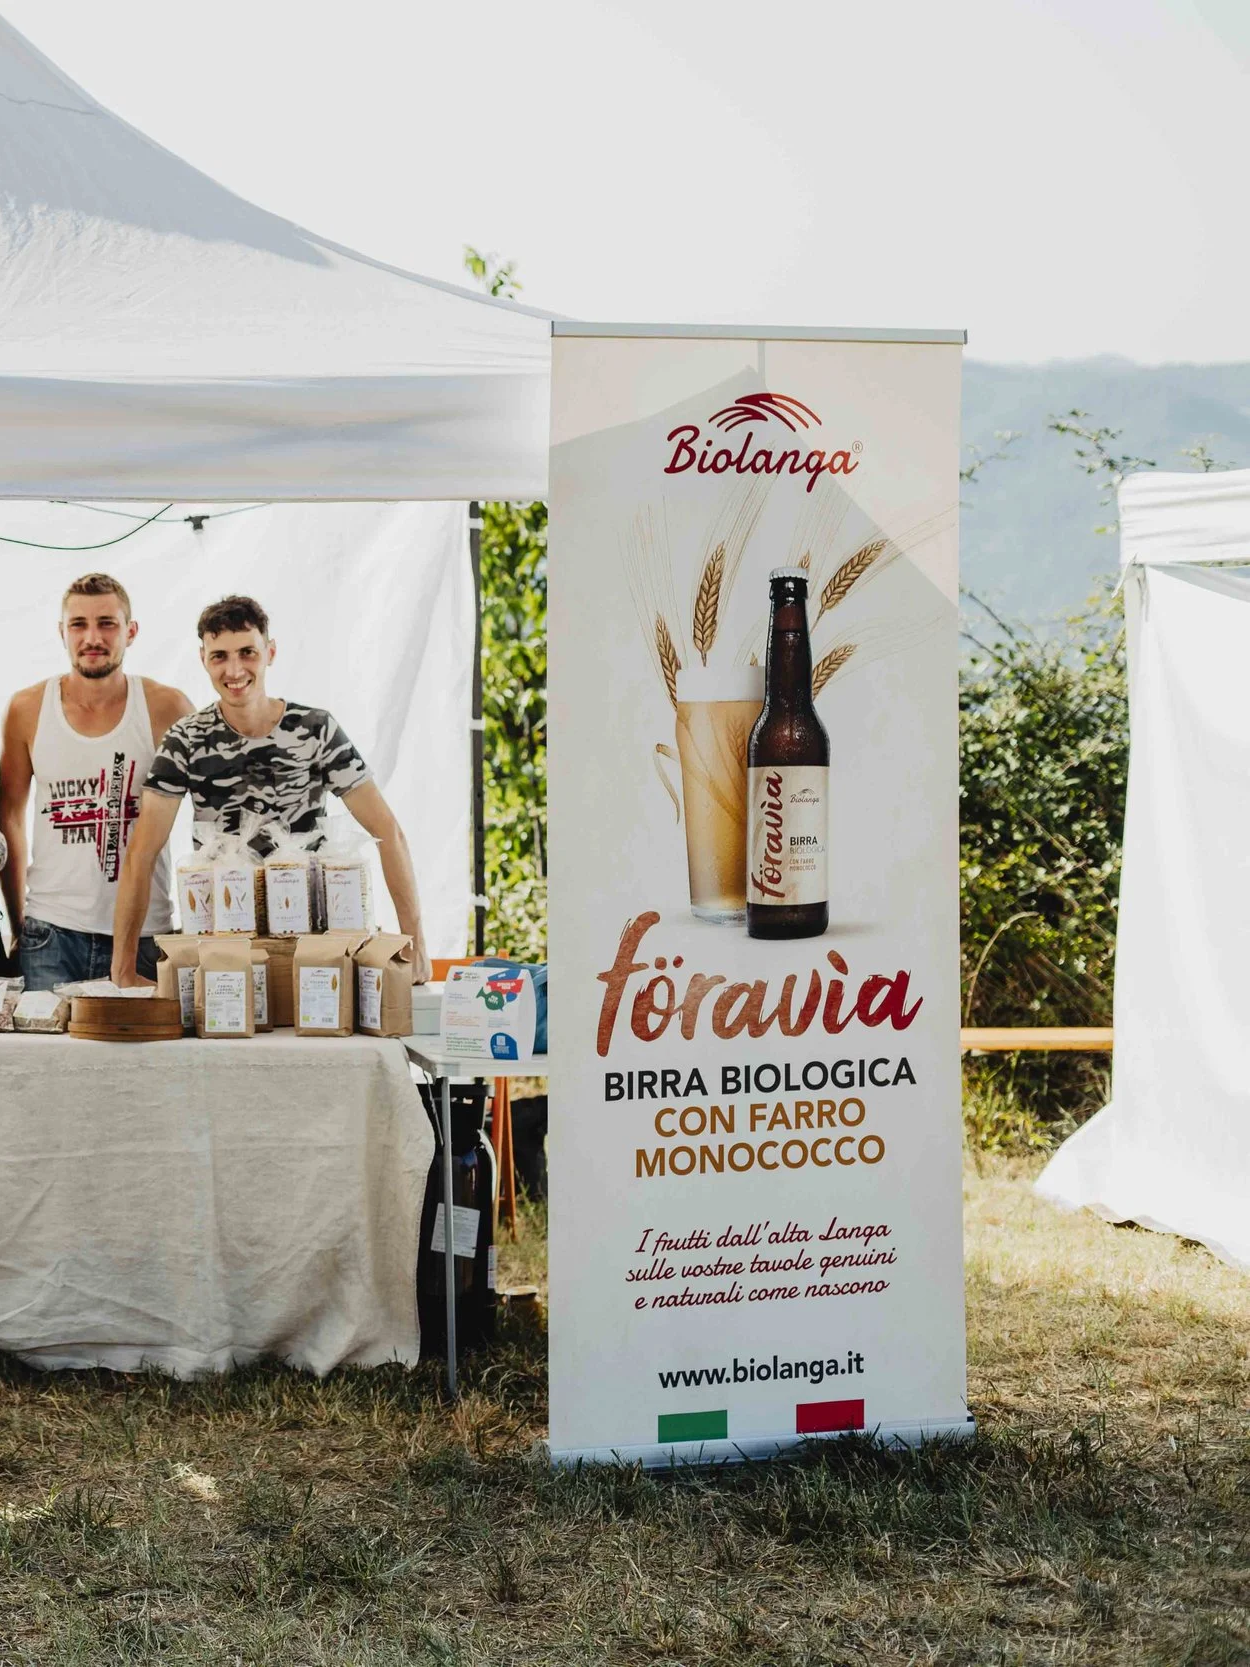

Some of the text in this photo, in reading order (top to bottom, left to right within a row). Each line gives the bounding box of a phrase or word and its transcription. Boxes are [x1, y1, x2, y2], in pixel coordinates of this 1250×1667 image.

[49, 779, 98, 799] LUCKY
[790, 836, 817, 846] BIRRA
[790, 846, 825, 855] BIOLOGICA
[605, 1057, 917, 1101] BIRRA BIOLOGICA
[654, 1098, 866, 1138] CON FARRO
[635, 1134, 886, 1178] MONOCOCCO
[635, 1217, 892, 1256] I frutti dall'alta Langa
[626, 1247, 897, 1282] sulle vostre tavole genuini
[635, 1277, 889, 1310] e naturali come nascono
[659, 1351, 864, 1389] www.biolanga.it
